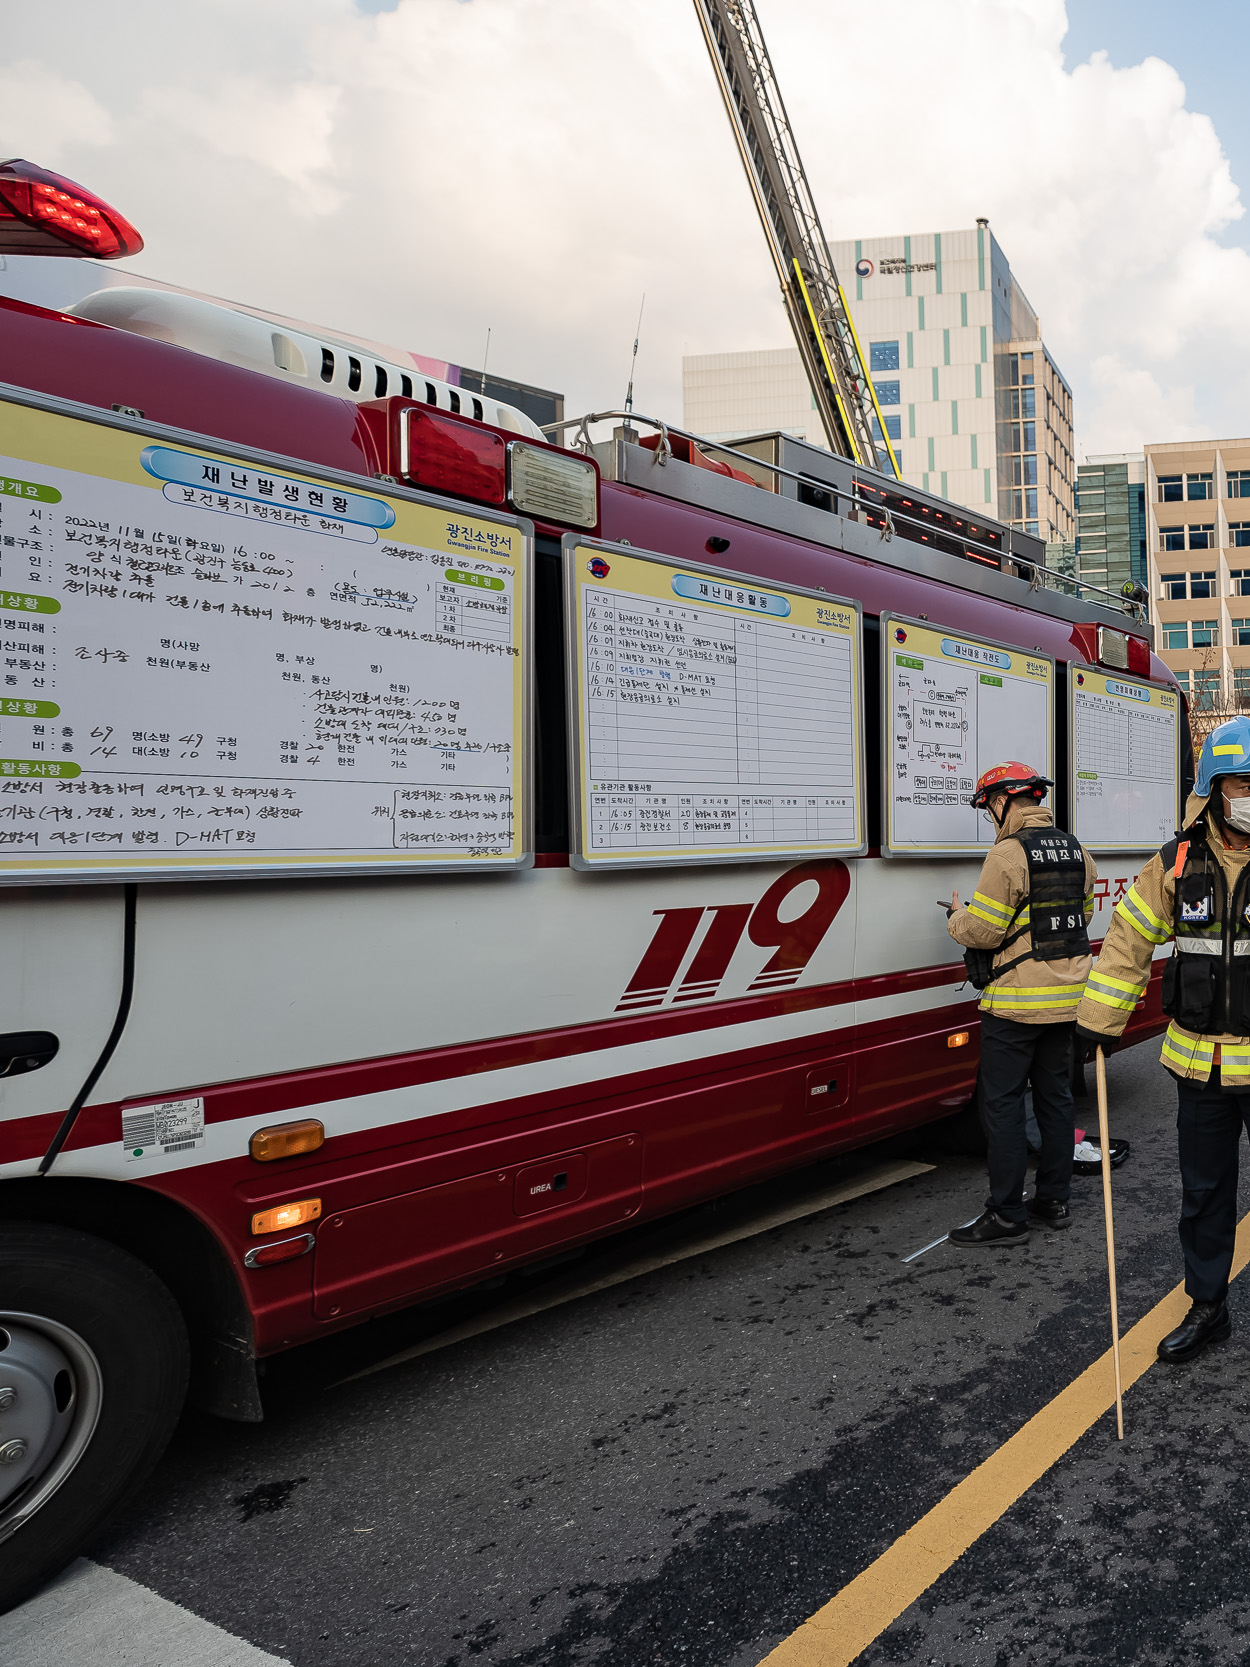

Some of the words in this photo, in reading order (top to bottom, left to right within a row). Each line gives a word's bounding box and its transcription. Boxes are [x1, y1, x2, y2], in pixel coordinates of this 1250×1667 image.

[880, 263, 937, 274] 국립정신건강센터
[0, 480, 39, 498] 개요
[202, 464, 348, 513] 재난발생현황
[319, 518, 344, 534] 화재
[446, 522, 512, 550] 광진소방서
[447, 539, 476, 551] Gwangjin
[477, 545, 489, 553] Fire
[490, 548, 510, 558] Station
[457, 572, 491, 587] 브리핑
[0, 594, 38, 610] 상황
[699, 584, 768, 608] 재난대응활동
[816, 607, 850, 624] 광진소방서
[0, 618, 44, 634] 명피해
[160, 639, 200, 652] 명(사망
[295, 655, 315, 666] 부상
[955, 645, 980, 659] 재난대응
[982, 652, 1001, 664] 작전도
[0, 641, 44, 655] 산피해
[146, 656, 211, 672] 천원(부동산
[311, 675, 330, 685] 동산
[4, 658, 46, 672] 부동산
[1026, 661, 1048, 674] 광진소방서
[61, 726, 74, 737] 총
[90, 726, 114, 743] 69
[132, 731, 170, 743] 명(소방
[178, 733, 203, 748] 49
[216, 736, 237, 747] 구청
[279, 740, 299, 751] 경찰
[337, 744, 355, 753] 한전
[391, 748, 407, 757] 가스
[441, 751, 455, 759] 기타
[61, 742, 74, 753] 총
[90, 746, 117, 759] 14
[132, 747, 170, 758] 대(소방
[216, 751, 237, 761] 구청
[279, 754, 299, 764] 경찰
[306, 755, 320, 766] 4
[337, 757, 355, 767] 한전
[391, 760, 407, 769] 가스
[441, 763, 455, 771] 기타
[0, 762, 62, 776] 활동사항
[600, 783, 626, 791] 유관기관
[628, 784, 652, 792] 활동사항
[611, 809, 633, 818] 16:05
[680, 810, 691, 818] 20
[611, 822, 632, 831] 16:15
[1030, 849, 1082, 862] 화재조사
[614, 858, 851, 1012] 119
[194, 1099, 200, 1108] J
[530, 1183, 551, 1195] UREA
